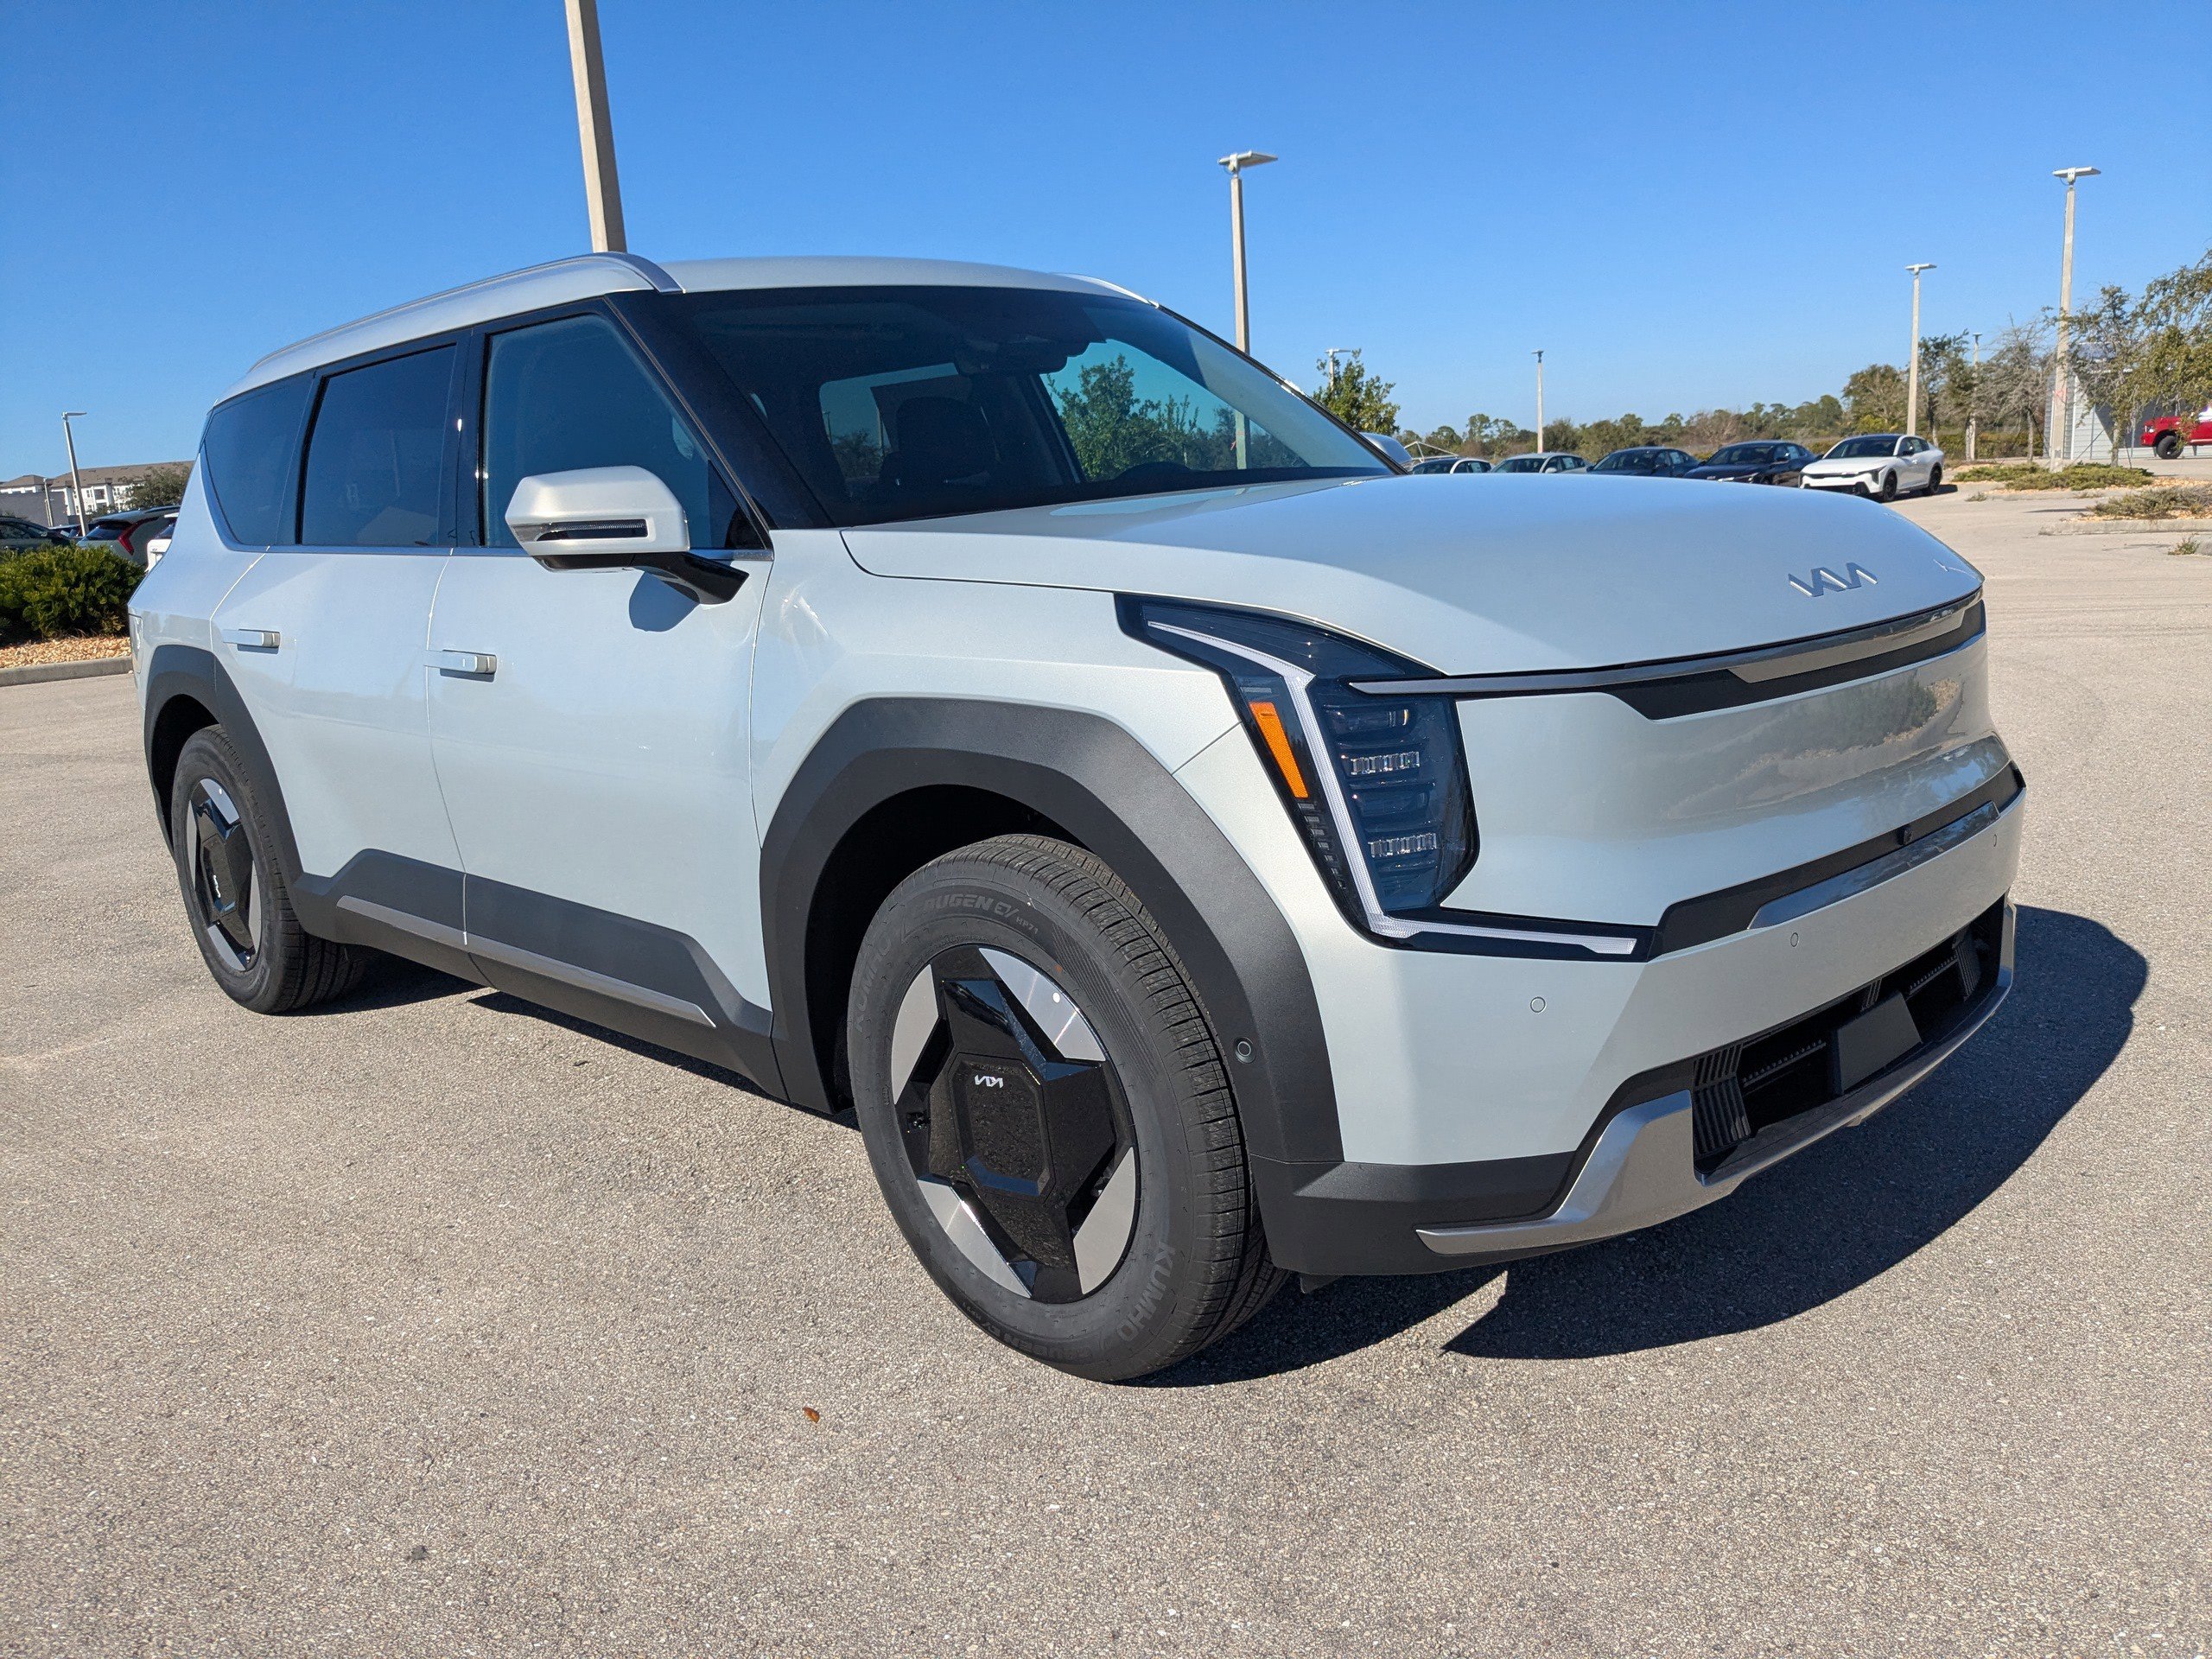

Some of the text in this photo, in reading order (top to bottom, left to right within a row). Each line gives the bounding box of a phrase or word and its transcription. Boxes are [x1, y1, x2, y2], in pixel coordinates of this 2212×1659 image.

[1788, 563, 1878, 597] KIA
[922, 893, 995, 912] RUGEN
[1116, 1241, 1175, 1342] KUMHO
